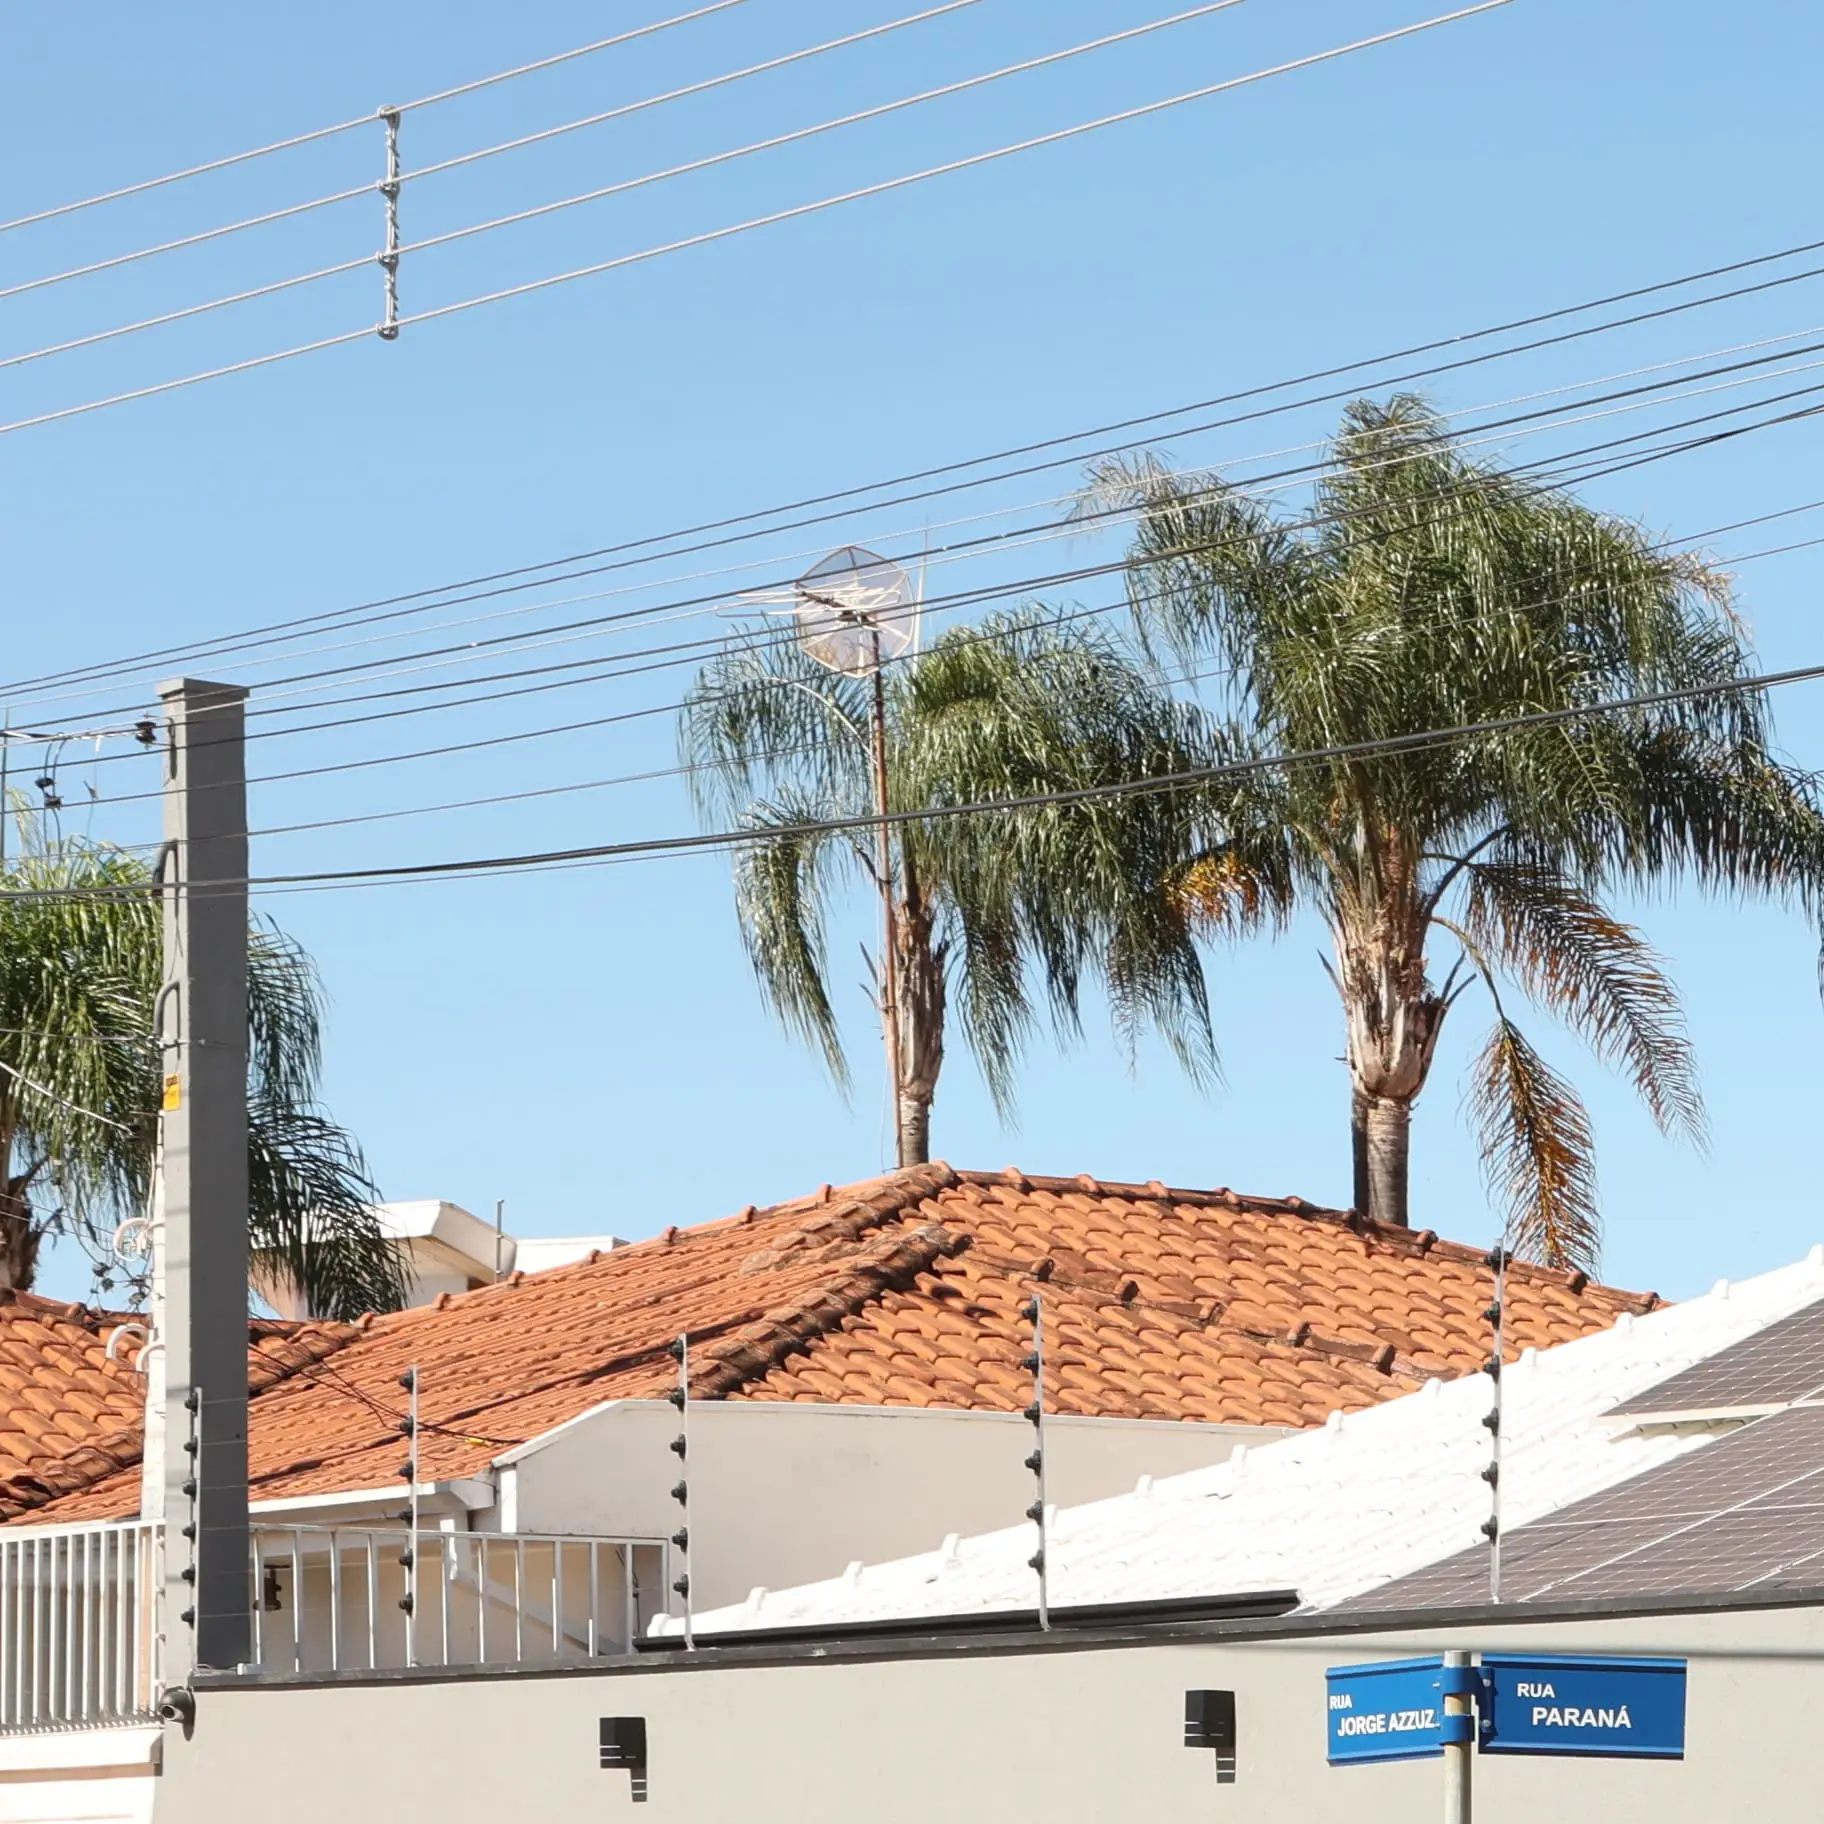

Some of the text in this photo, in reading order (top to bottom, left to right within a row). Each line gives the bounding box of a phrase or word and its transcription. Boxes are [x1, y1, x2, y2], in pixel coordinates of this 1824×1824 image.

[1517, 1683, 1555, 1698] RUA
[1330, 1694, 1352, 1710] RUA
[1337, 1709, 1435, 1737] JORGE AZZUZ
[1532, 1706, 1632, 1729] PARANÁ
